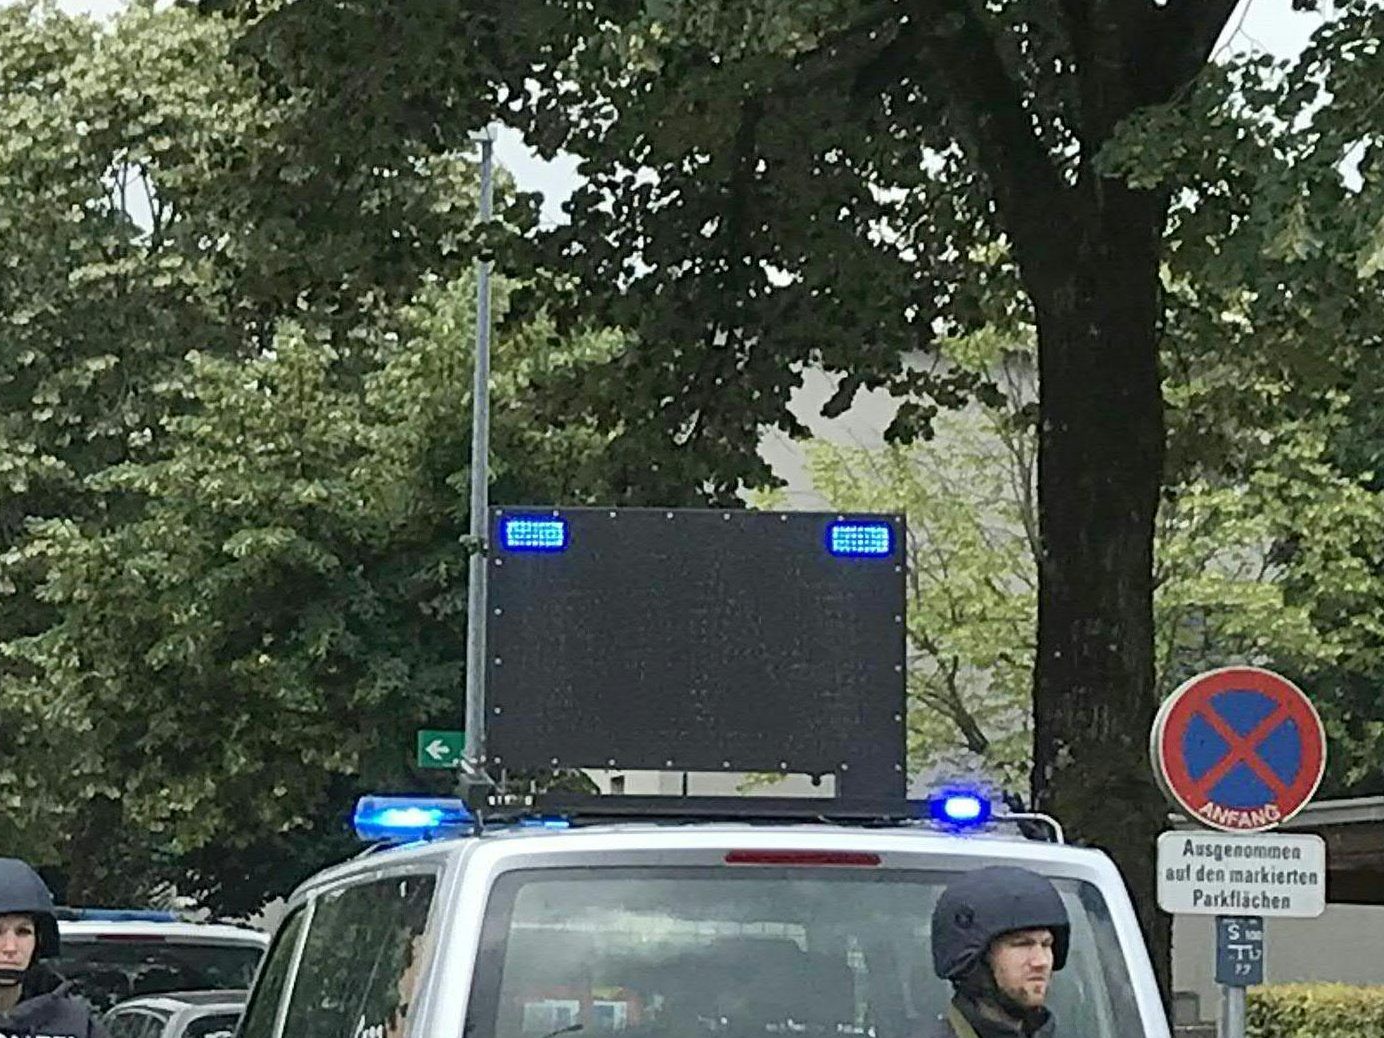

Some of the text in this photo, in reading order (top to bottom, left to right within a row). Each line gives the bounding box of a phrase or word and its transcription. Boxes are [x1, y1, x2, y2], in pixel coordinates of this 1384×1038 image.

[1199, 802, 1281, 828] ANFANG
[1183, 839, 1301, 861] Ausgenommen
[1166, 865, 1318, 885] auf den markierten
[1193, 889, 1291, 909] Parkflächen
